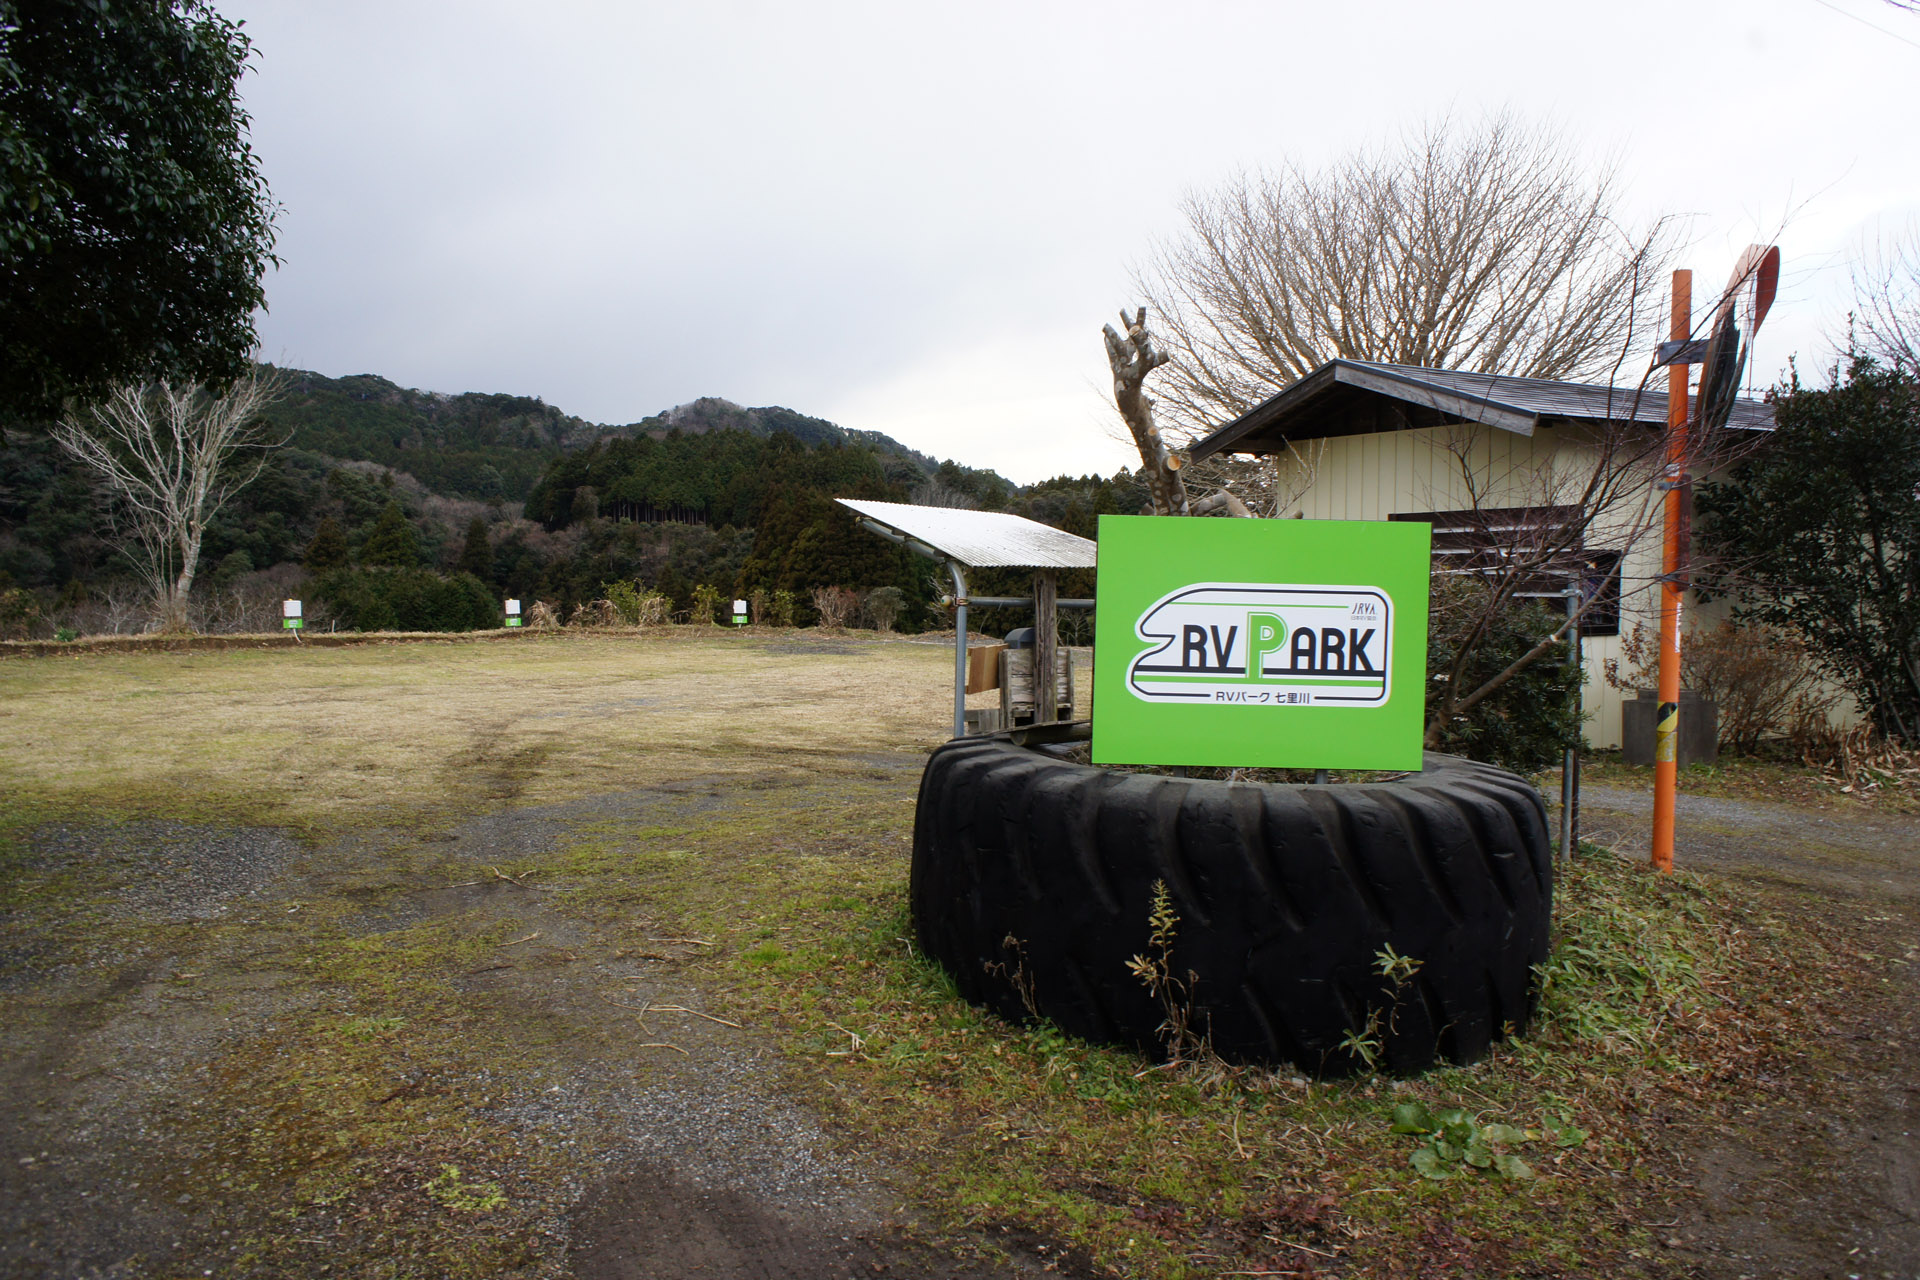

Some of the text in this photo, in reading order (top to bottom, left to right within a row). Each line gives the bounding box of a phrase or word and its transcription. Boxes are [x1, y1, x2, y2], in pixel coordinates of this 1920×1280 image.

[1182, 611, 1377, 679] RV PARK
[1274, 692, 1310, 704] 七里川
